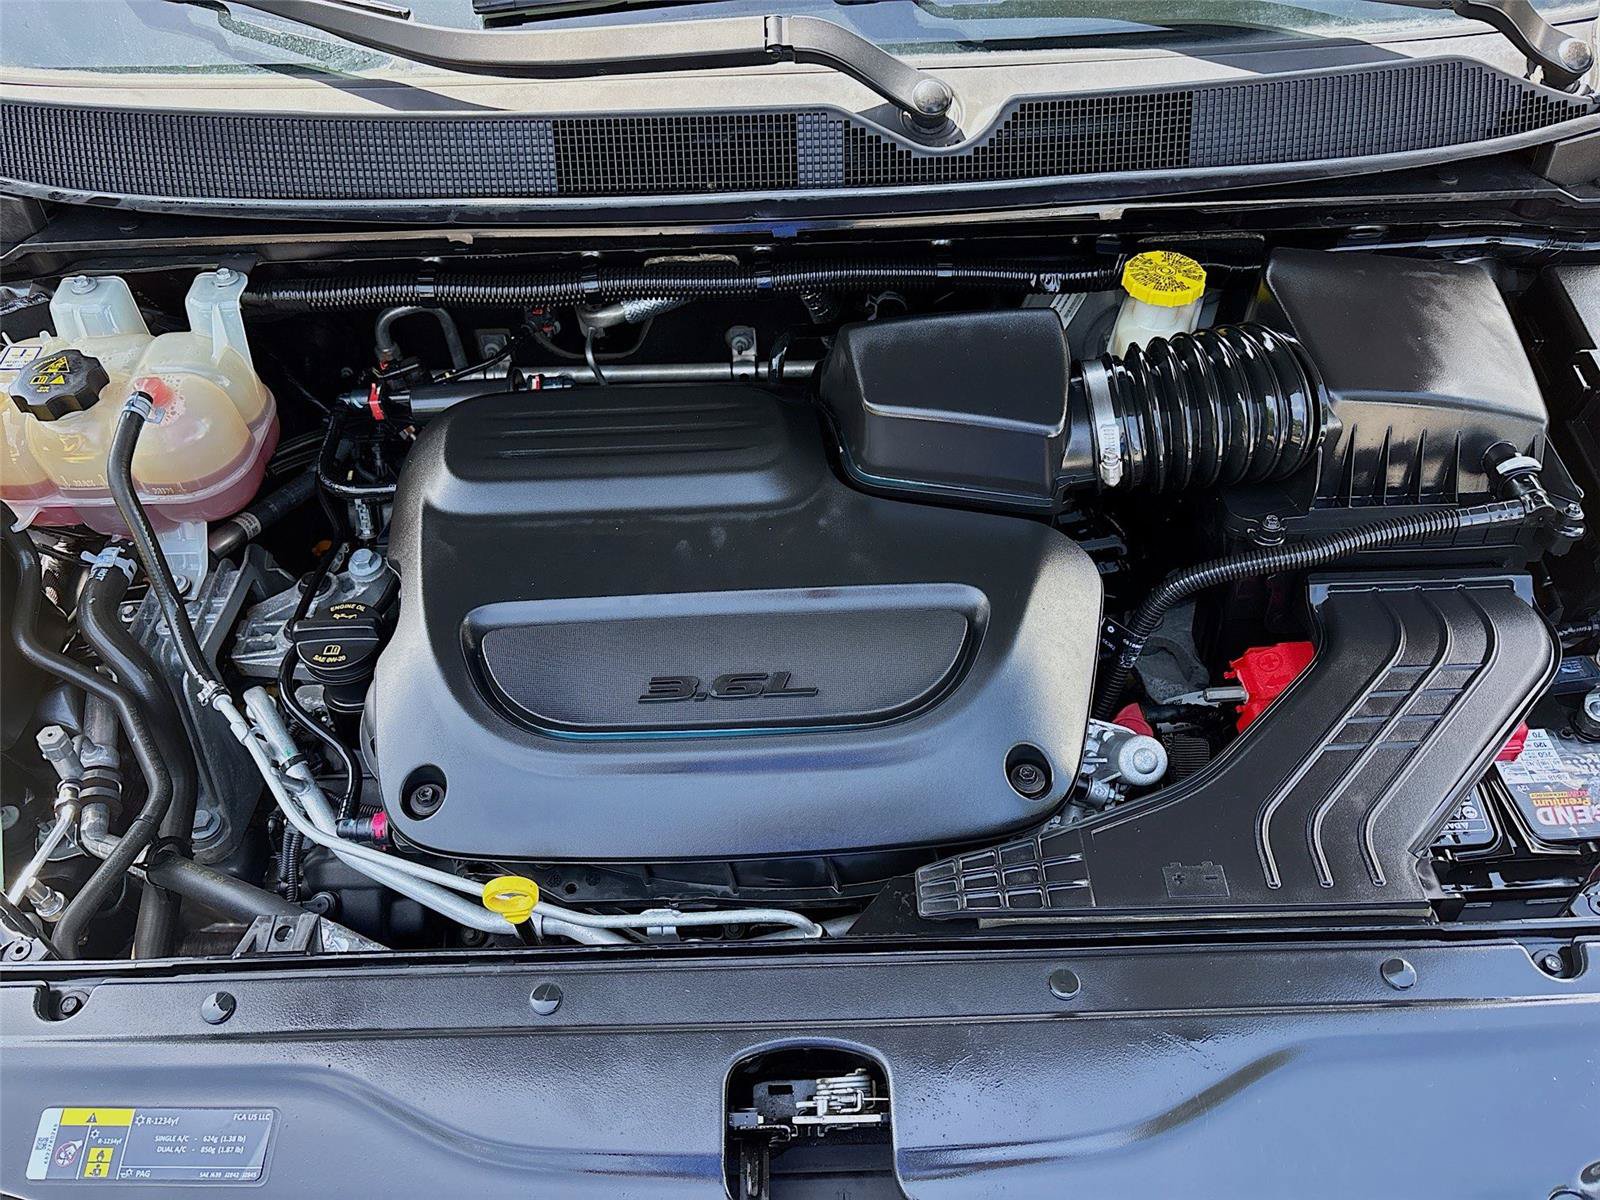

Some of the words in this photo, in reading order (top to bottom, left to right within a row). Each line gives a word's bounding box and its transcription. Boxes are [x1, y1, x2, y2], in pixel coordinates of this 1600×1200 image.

[330, 603, 356, 612] ENGINE
[356, 604, 366, 612] OIL
[313, 655, 325, 663] SAE
[638, 671, 819, 704] 3.6L
[1533, 797, 1592, 807] Premium
[146, 1116, 179, 1126] R-1234yf
[233, 1113, 247, 1121] FCA
[248, 1113, 258, 1121] US
[258, 1113, 271, 1121] LLC
[136, 1169, 151, 1178] PAG
